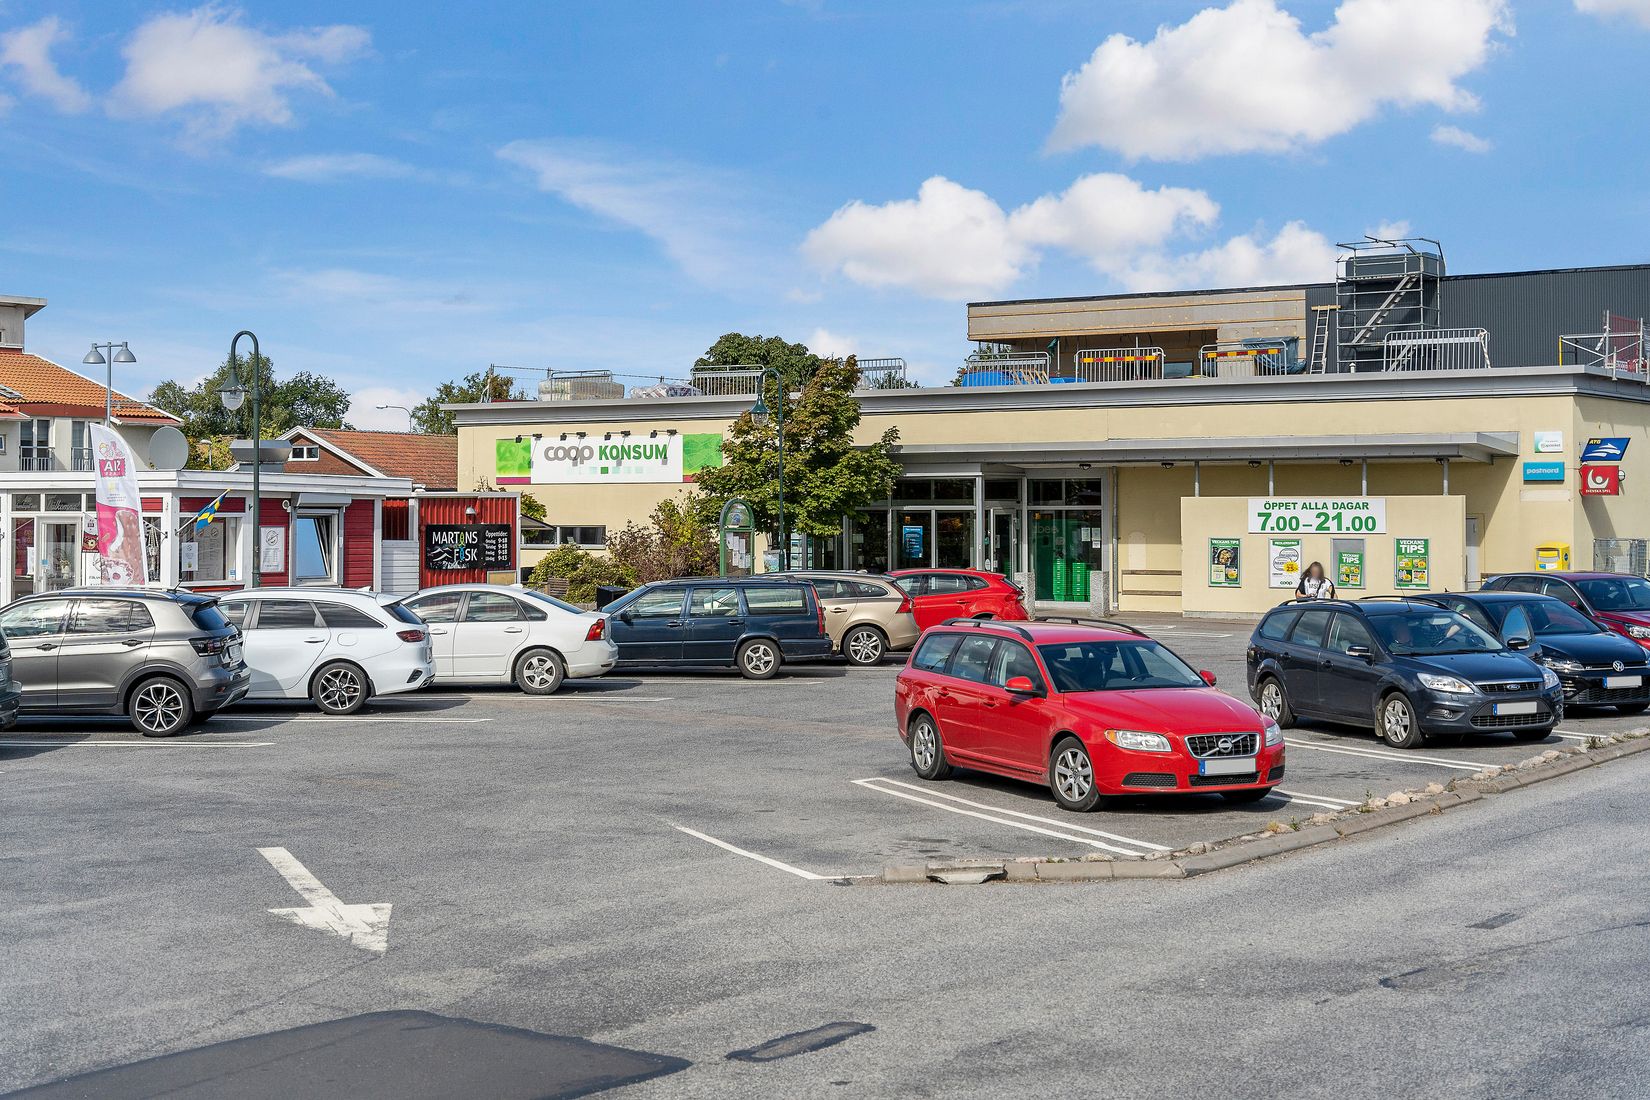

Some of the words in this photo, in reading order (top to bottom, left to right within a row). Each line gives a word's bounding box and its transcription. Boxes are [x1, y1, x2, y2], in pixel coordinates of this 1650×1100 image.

[599, 444, 667, 460] KONSUM
[1264, 501, 1298, 510] ÖPPET
[1301, 502, 1328, 510] ALLA
[1332, 502, 1369, 510] DAGAR
[1400, 545, 1424, 554] TIPS
